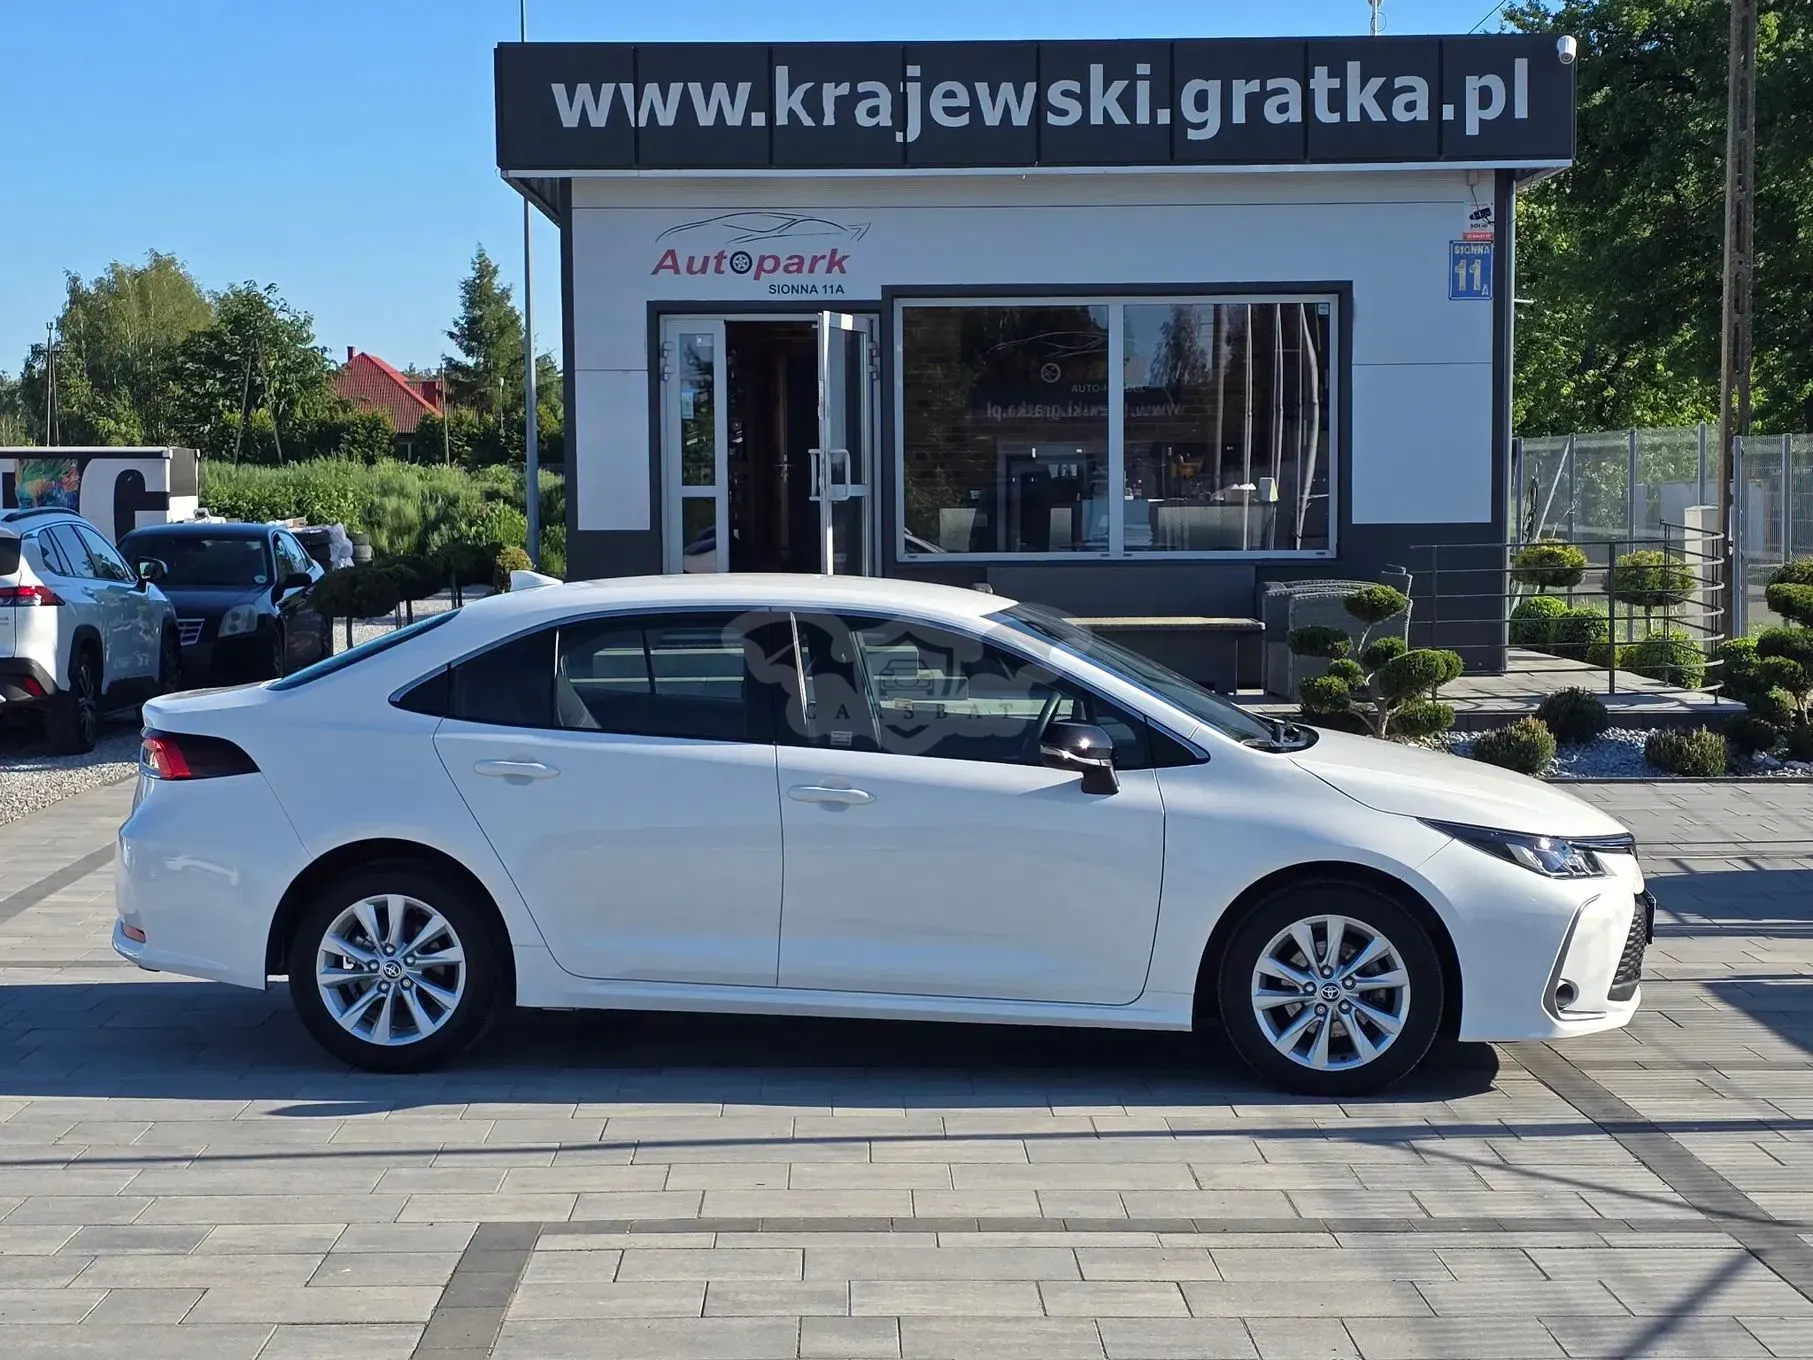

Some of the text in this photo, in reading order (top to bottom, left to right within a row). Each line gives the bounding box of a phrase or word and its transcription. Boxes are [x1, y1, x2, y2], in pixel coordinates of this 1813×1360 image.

[550, 58, 1529, 143] www.krajewski.gratka.pl
[650, 248, 851, 281] Autopark
[1454, 245, 1491, 255] SIONNA
[768, 284, 845, 295] SIONNA 11A
[1454, 259, 1482, 291] 11
